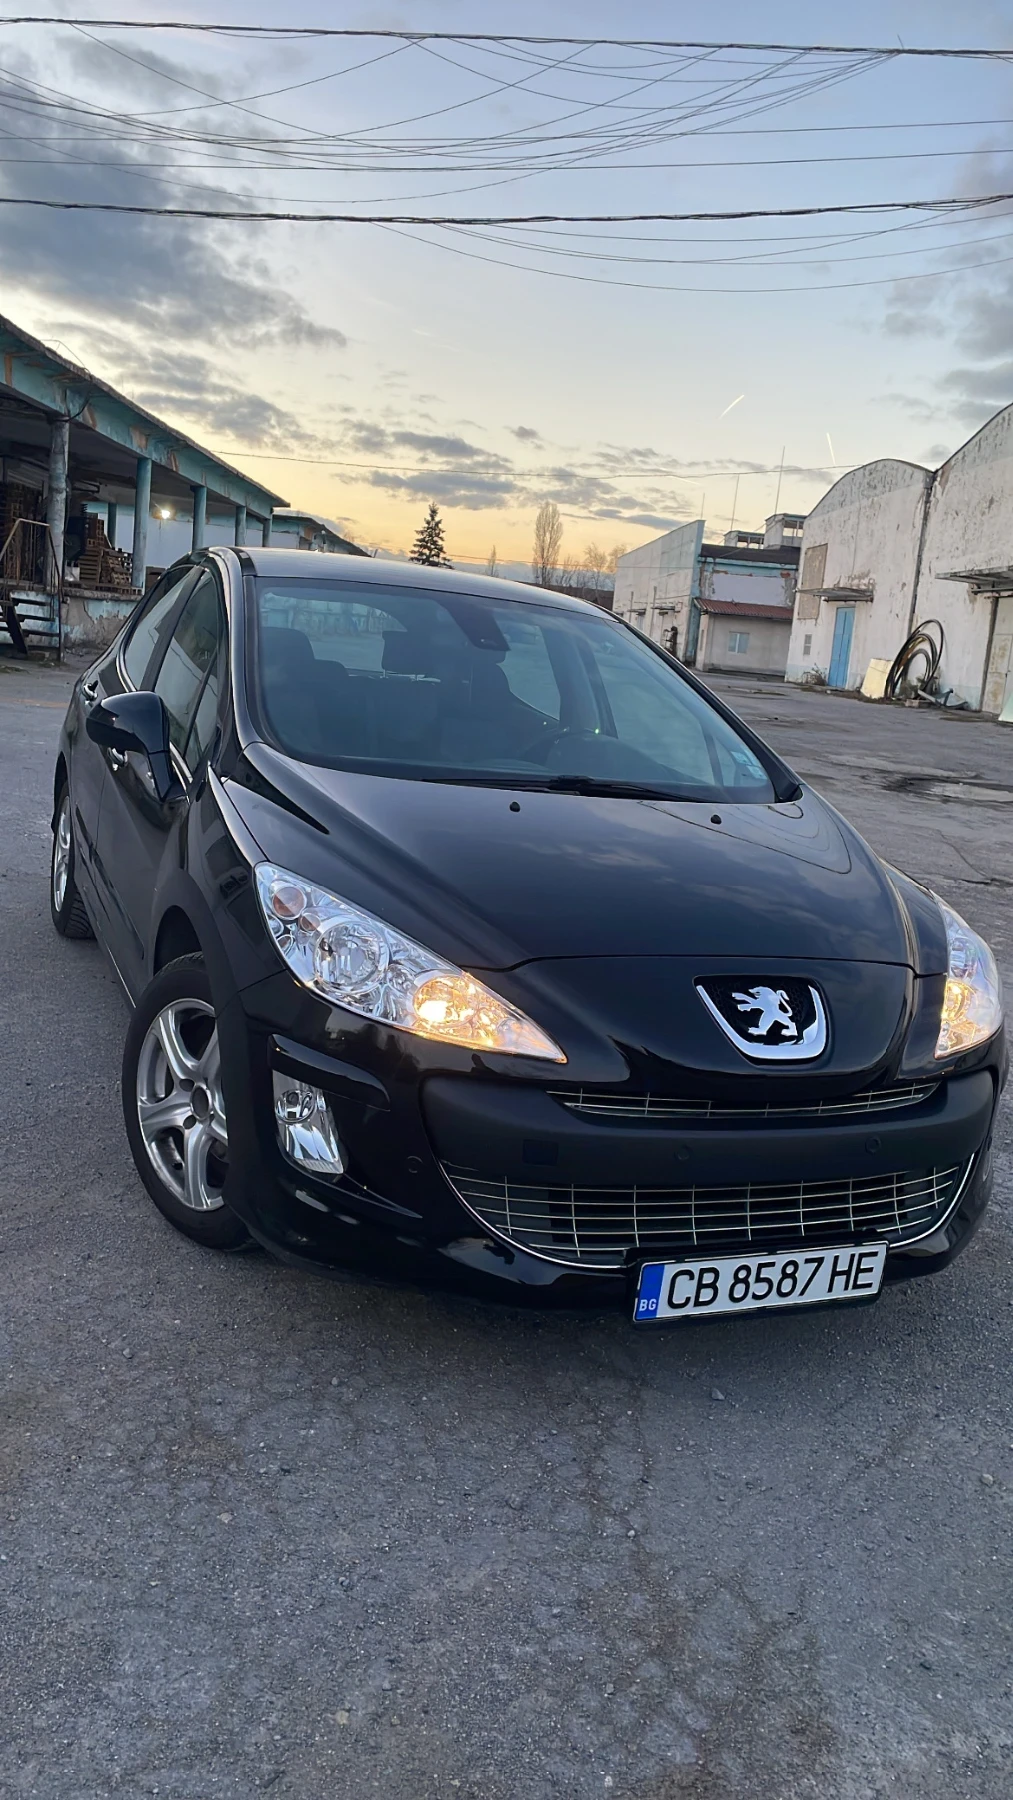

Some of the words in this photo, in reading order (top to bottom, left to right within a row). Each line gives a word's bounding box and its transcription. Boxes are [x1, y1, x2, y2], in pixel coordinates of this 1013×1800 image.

[667, 1266, 720, 1310] CB
[728, 1256, 825, 1304] 8587
[827, 1251, 879, 1293] HE
[639, 1298, 657, 1312] BG
